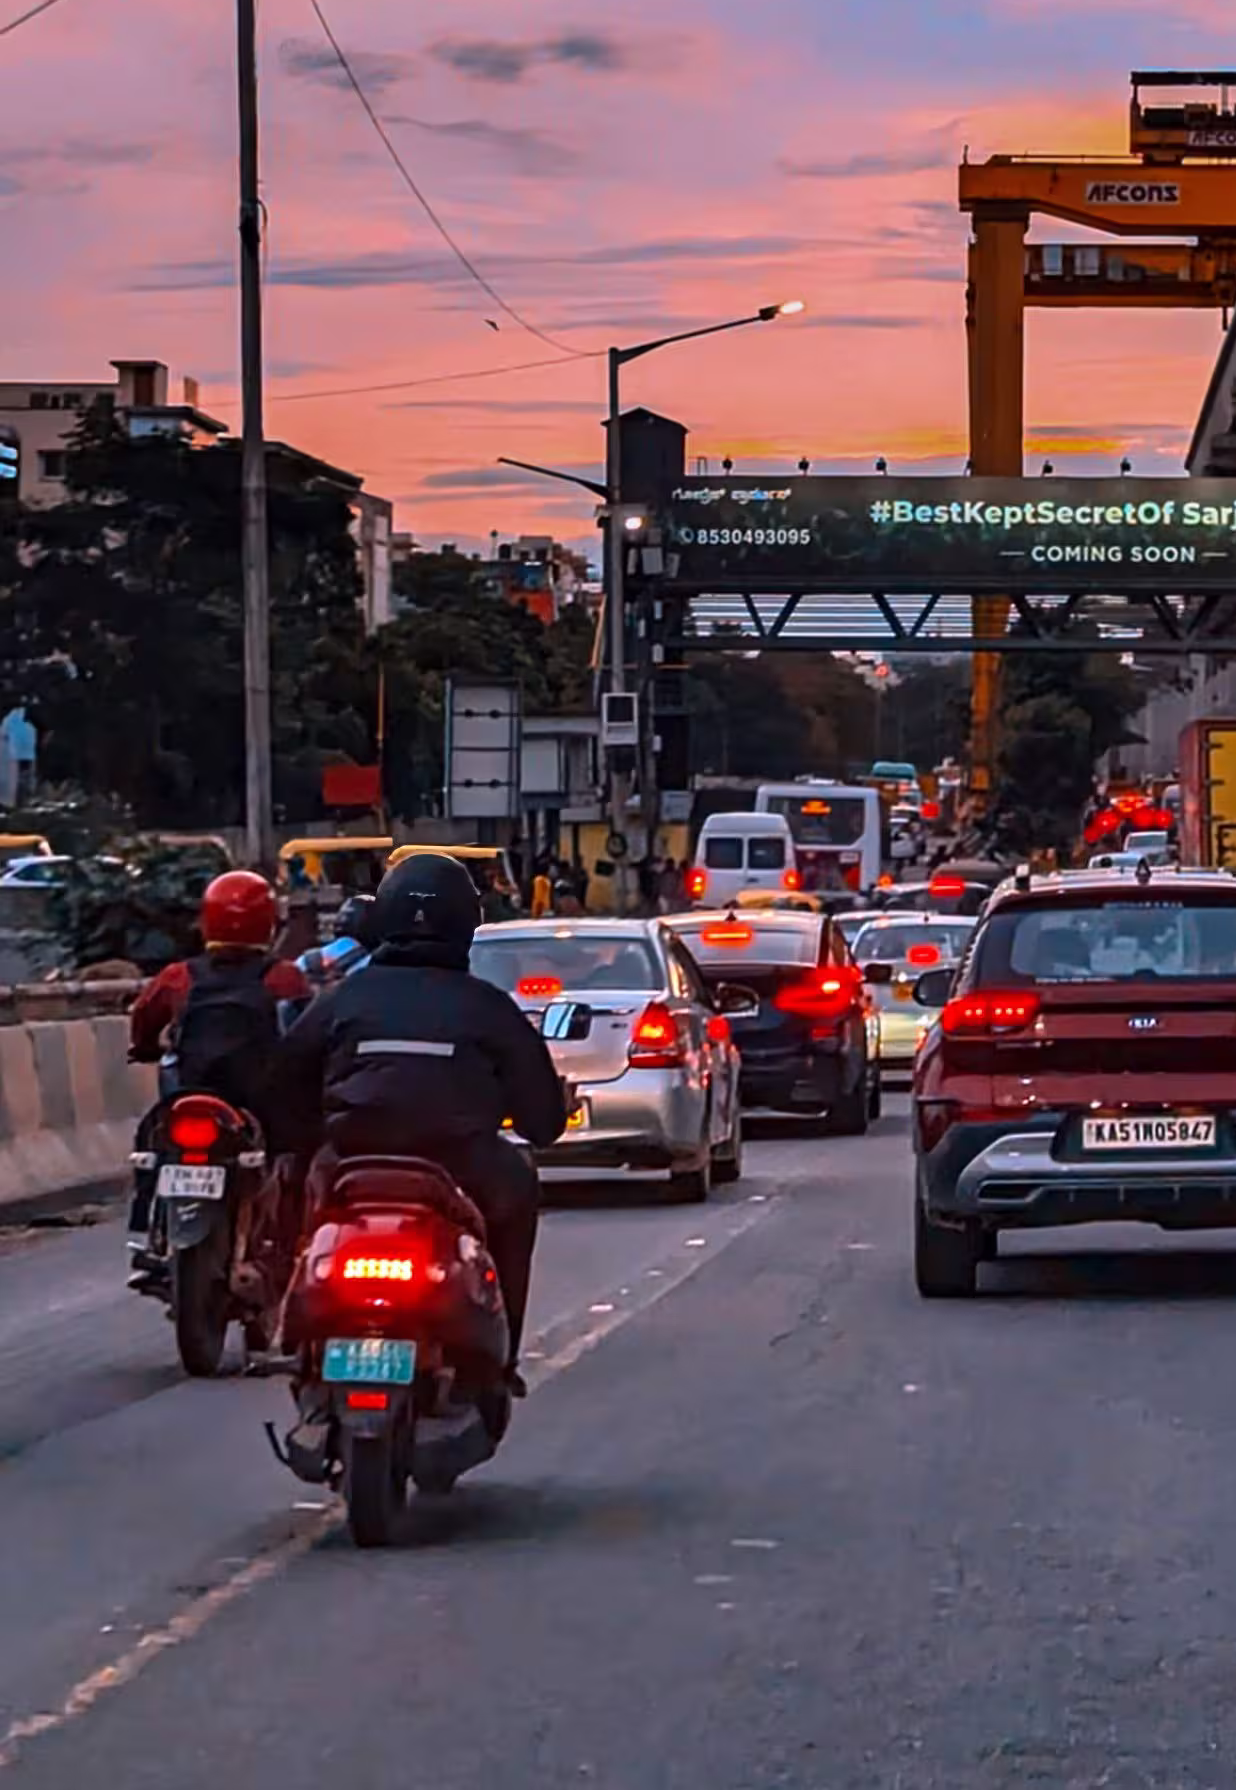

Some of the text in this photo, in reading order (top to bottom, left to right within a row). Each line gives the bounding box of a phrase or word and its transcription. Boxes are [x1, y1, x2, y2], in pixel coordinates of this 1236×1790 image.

[869, 501, 1175, 529] #BestKeptSecretOf
[697, 528, 811, 545] 8530493095
[1031, 545, 1196, 562] COMING SOON
